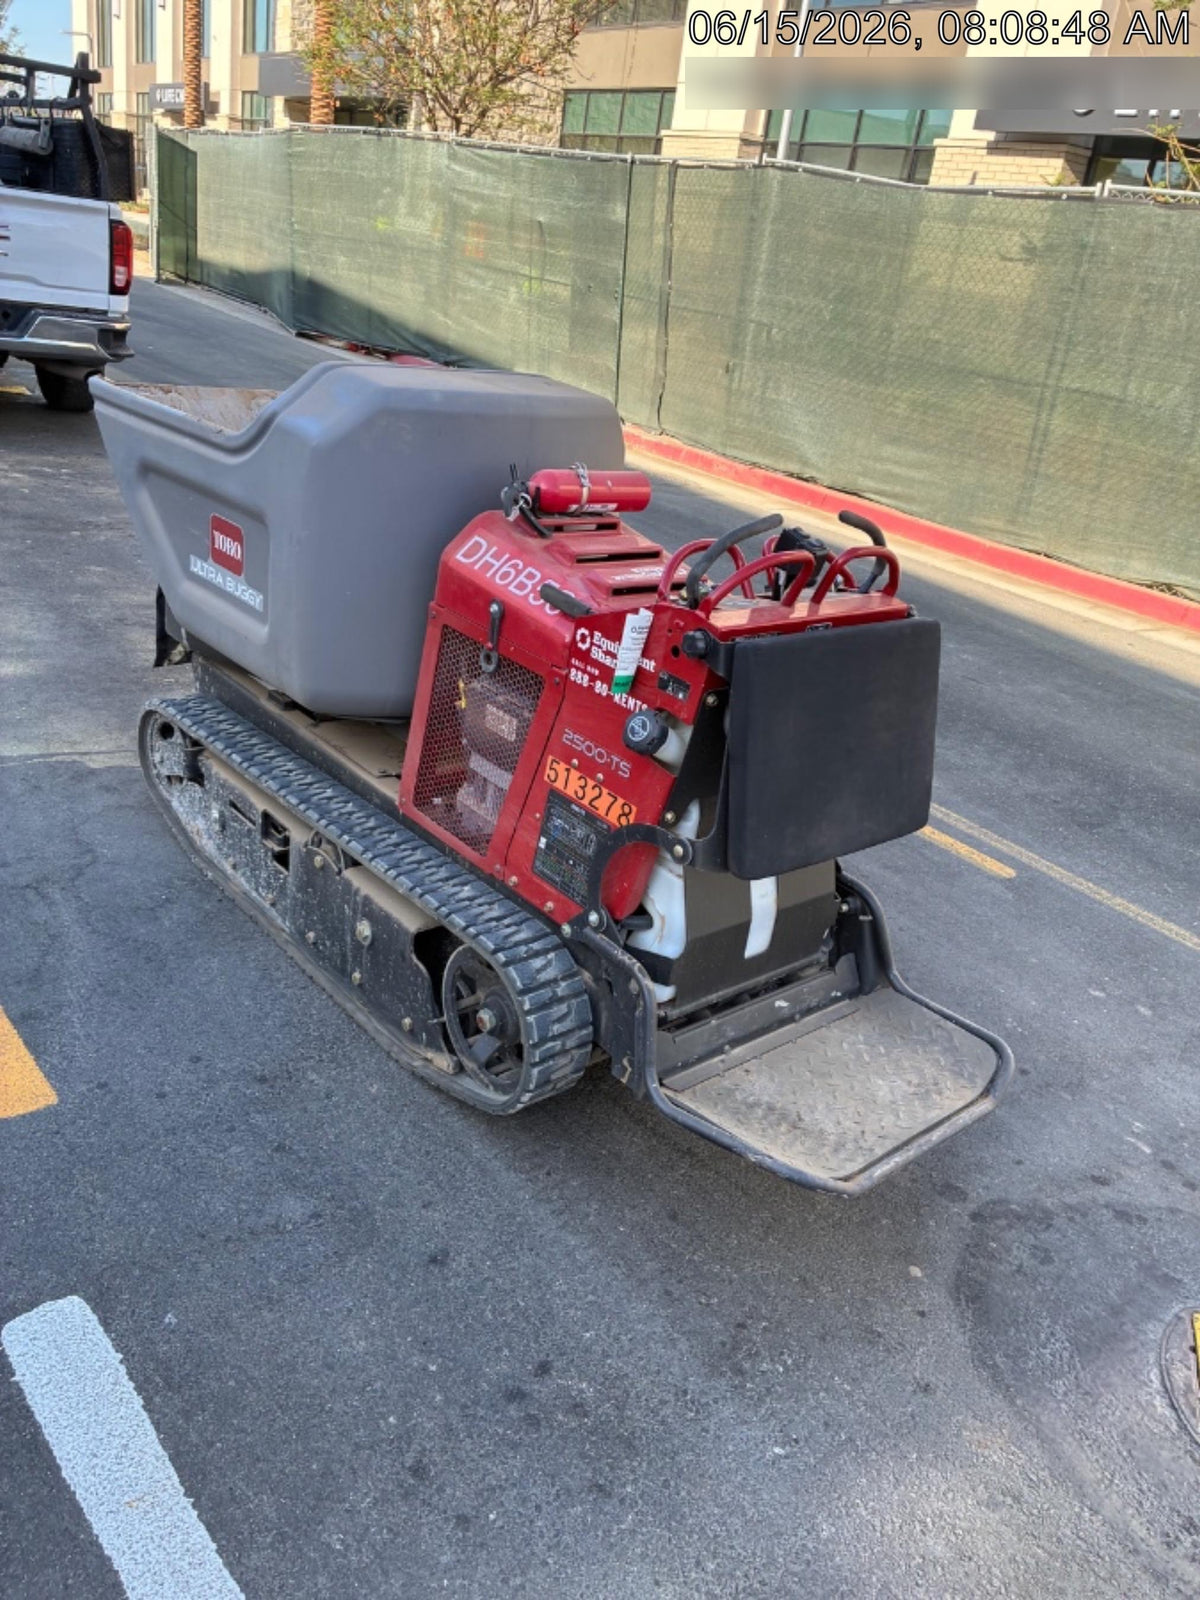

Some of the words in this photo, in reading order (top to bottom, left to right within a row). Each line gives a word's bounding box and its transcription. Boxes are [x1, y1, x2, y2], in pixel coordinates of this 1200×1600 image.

[212, 530, 242, 561] TORO
[189, 554, 225, 588] ULTRA
[226, 577, 264, 612] BUGGY
[592, 630, 657, 673] Equient
[547, 758, 634, 827] 513278
